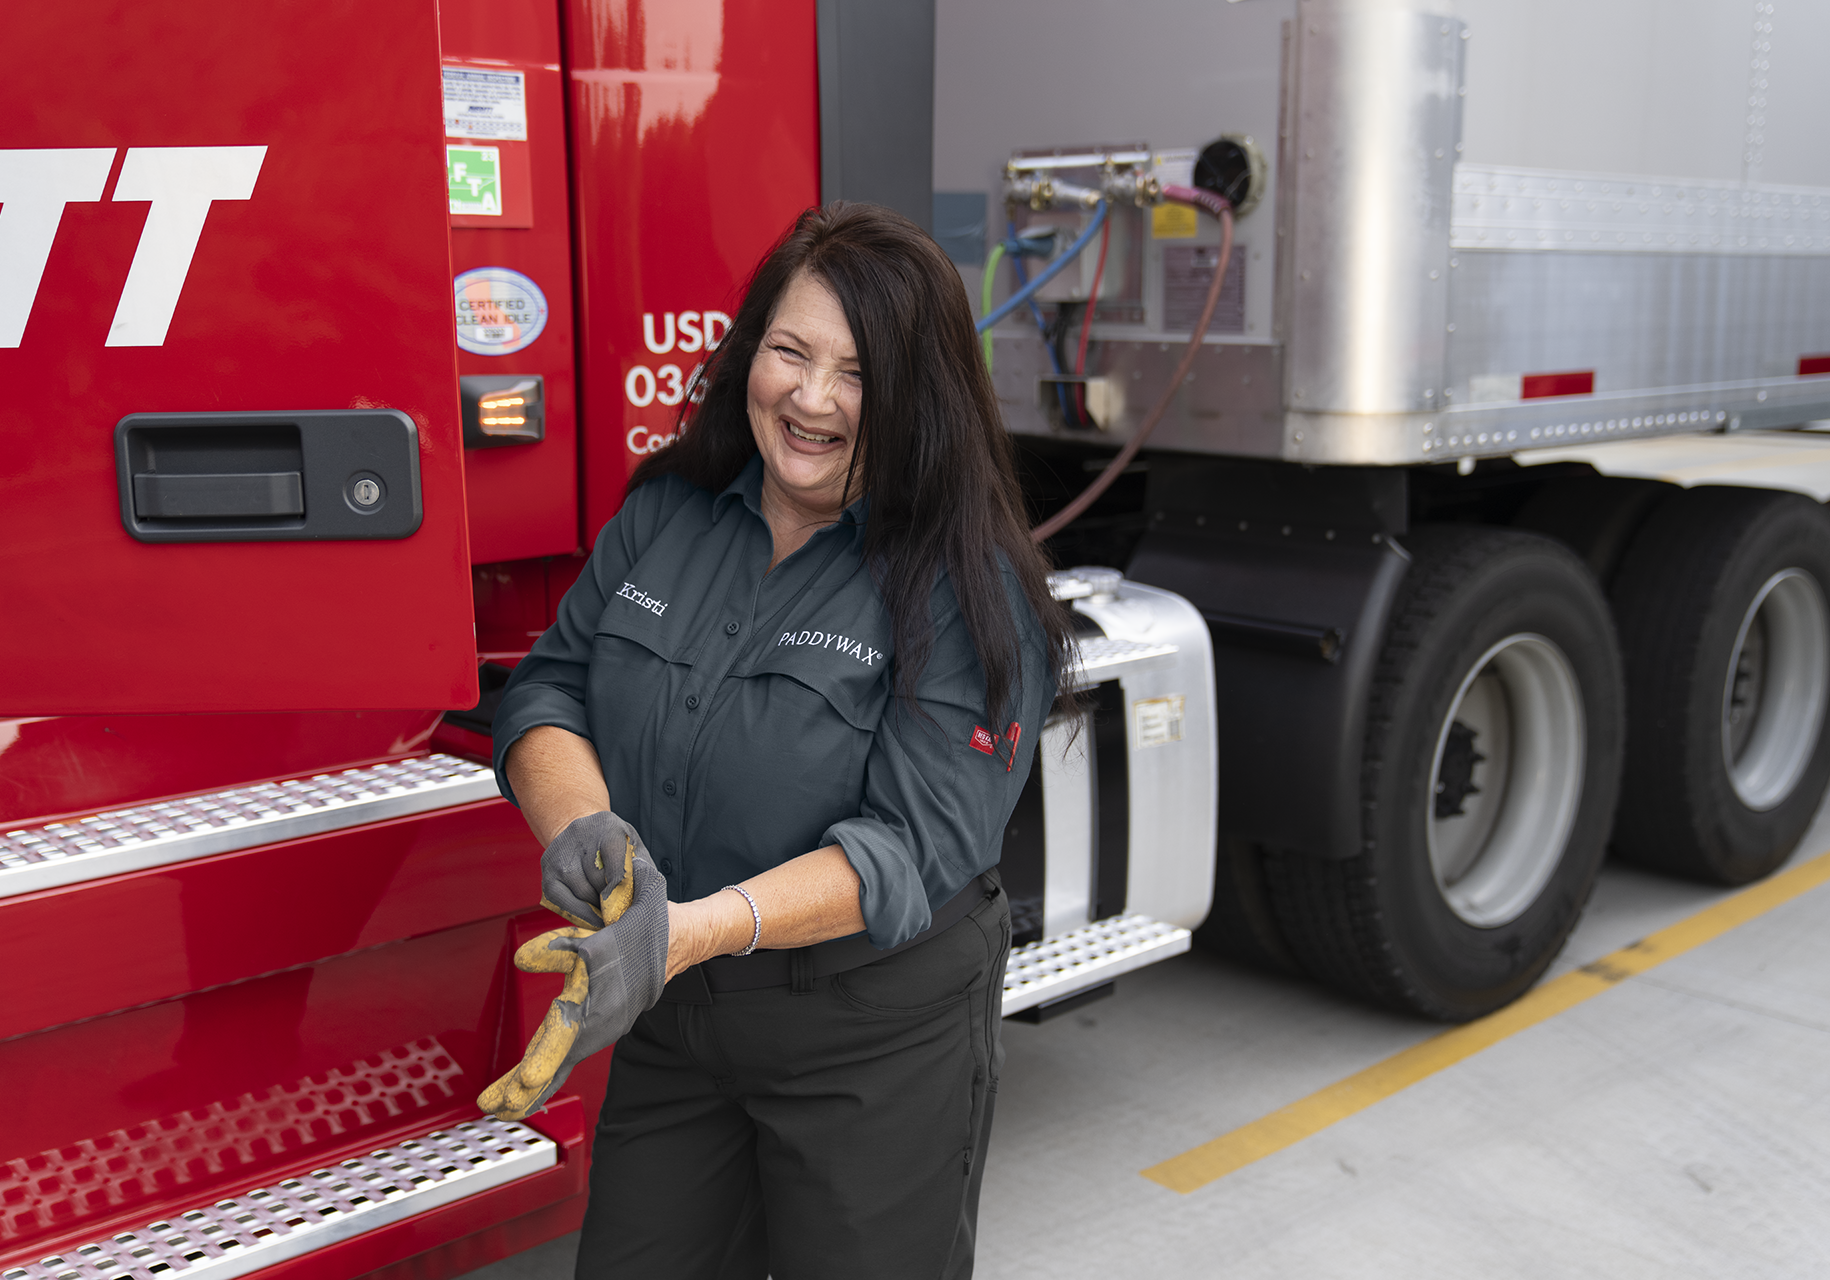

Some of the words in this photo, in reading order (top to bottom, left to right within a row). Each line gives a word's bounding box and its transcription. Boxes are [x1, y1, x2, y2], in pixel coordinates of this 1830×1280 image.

[480, 151, 495, 162] 23
[459, 299, 525, 312] CERTIFIED
[456, 313, 498, 326] CLEAN
[504, 312, 532, 324] IDLE
[616, 582, 669, 617] Kristi
